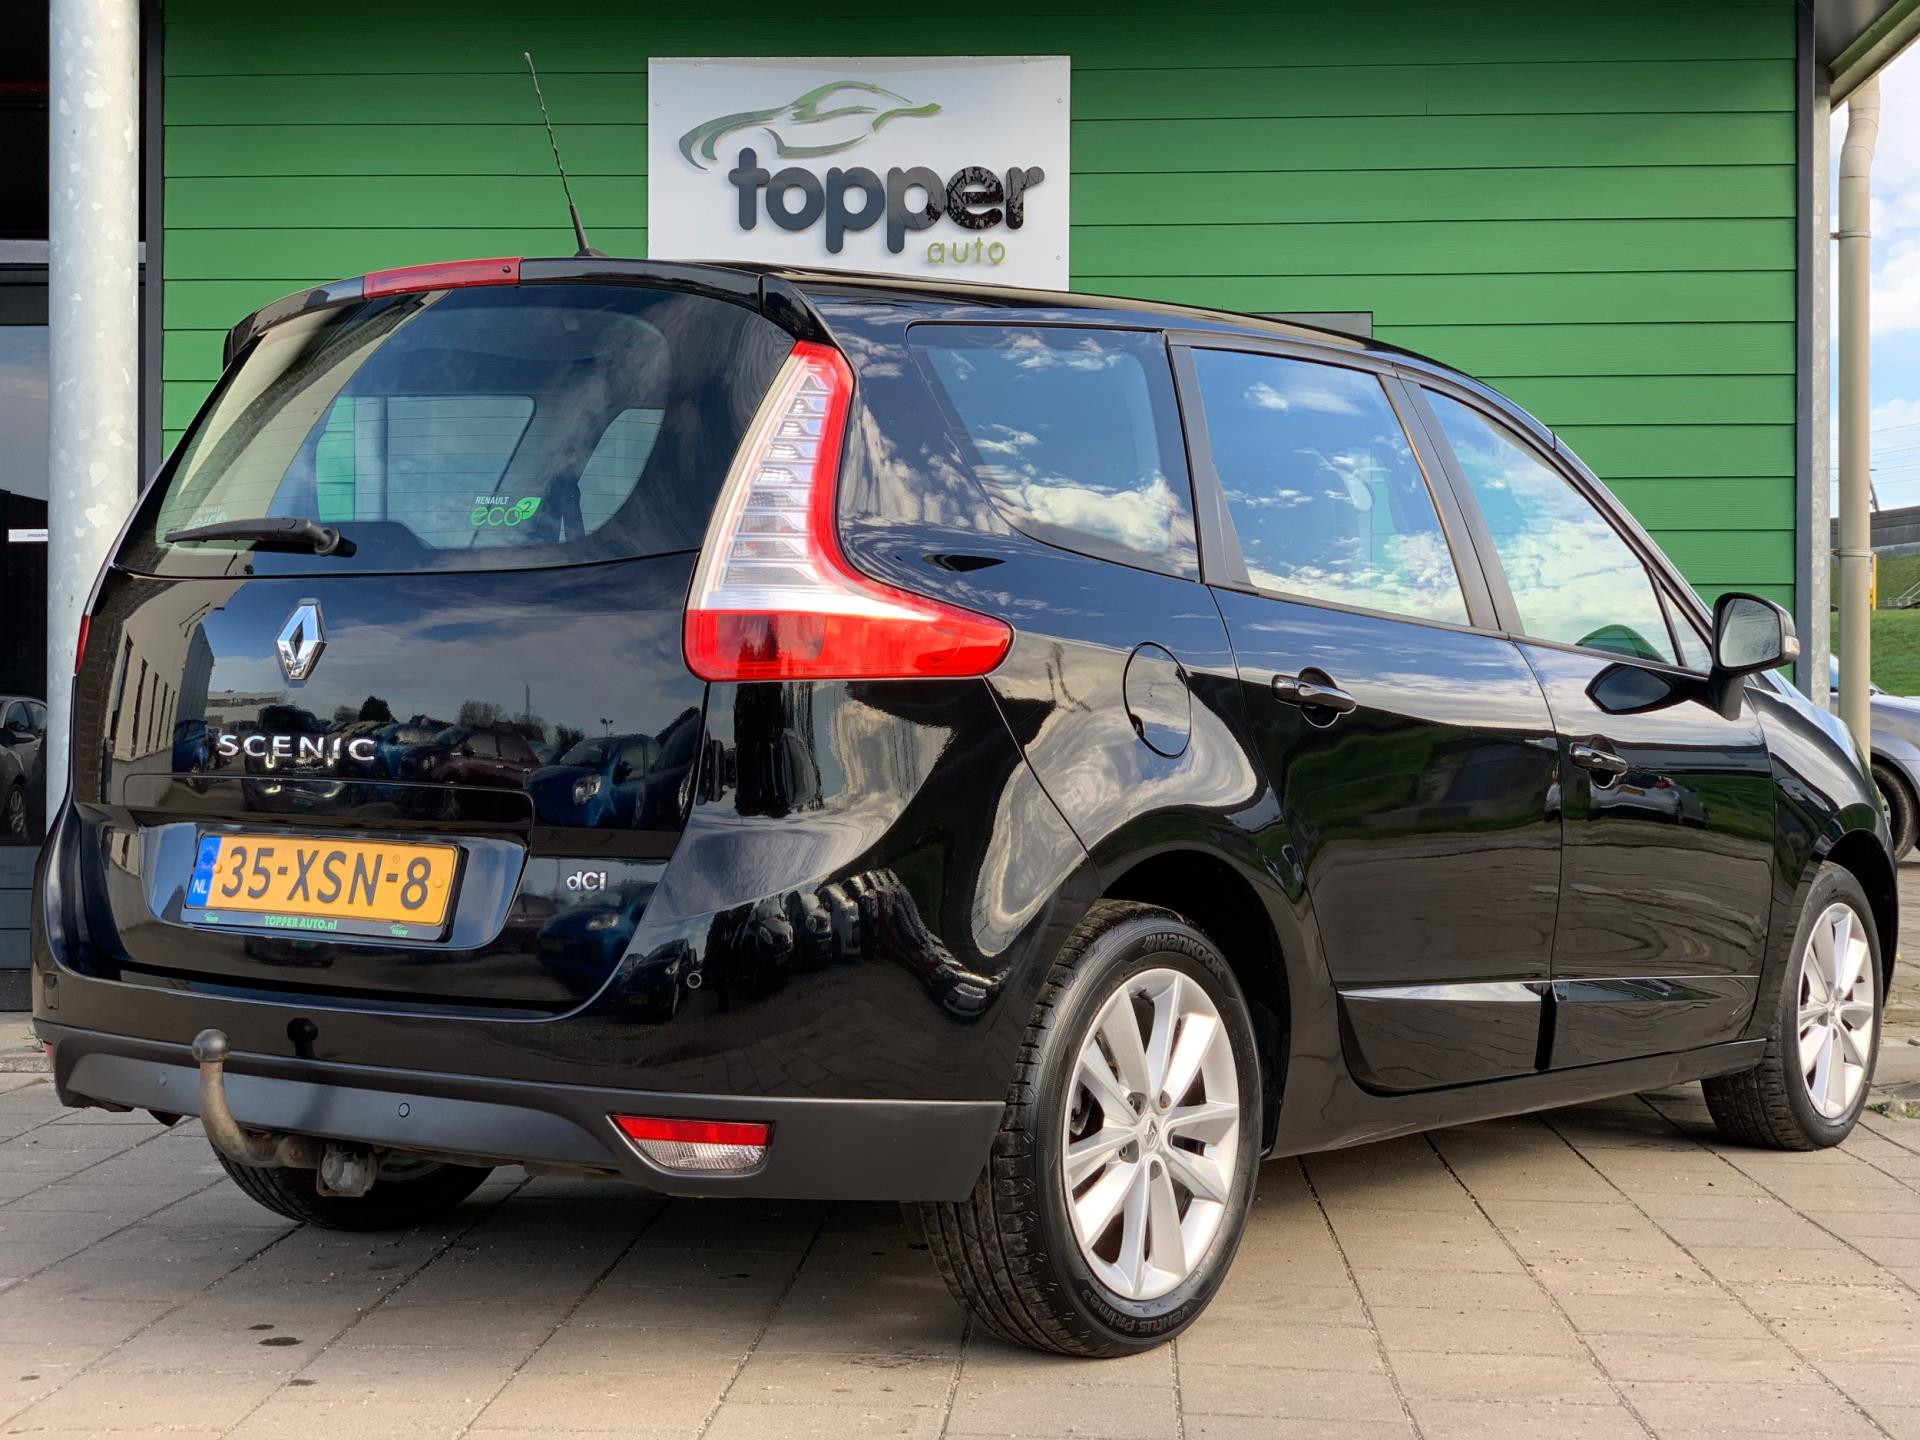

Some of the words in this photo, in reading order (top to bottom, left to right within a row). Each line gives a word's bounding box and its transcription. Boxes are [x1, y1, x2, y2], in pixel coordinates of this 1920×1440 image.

[728, 147, 1046, 254] topper
[926, 236, 1006, 265] auto
[475, 496, 510, 505] RENAULT
[218, 734, 376, 761] SCENIC
[192, 878, 208, 895] NL
[221, 846, 432, 910] 35-XSN-8
[566, 870, 607, 892] dCi
[264, 915, 298, 928] TOPPER
[299, 917, 338, 931] AUTO.nl
